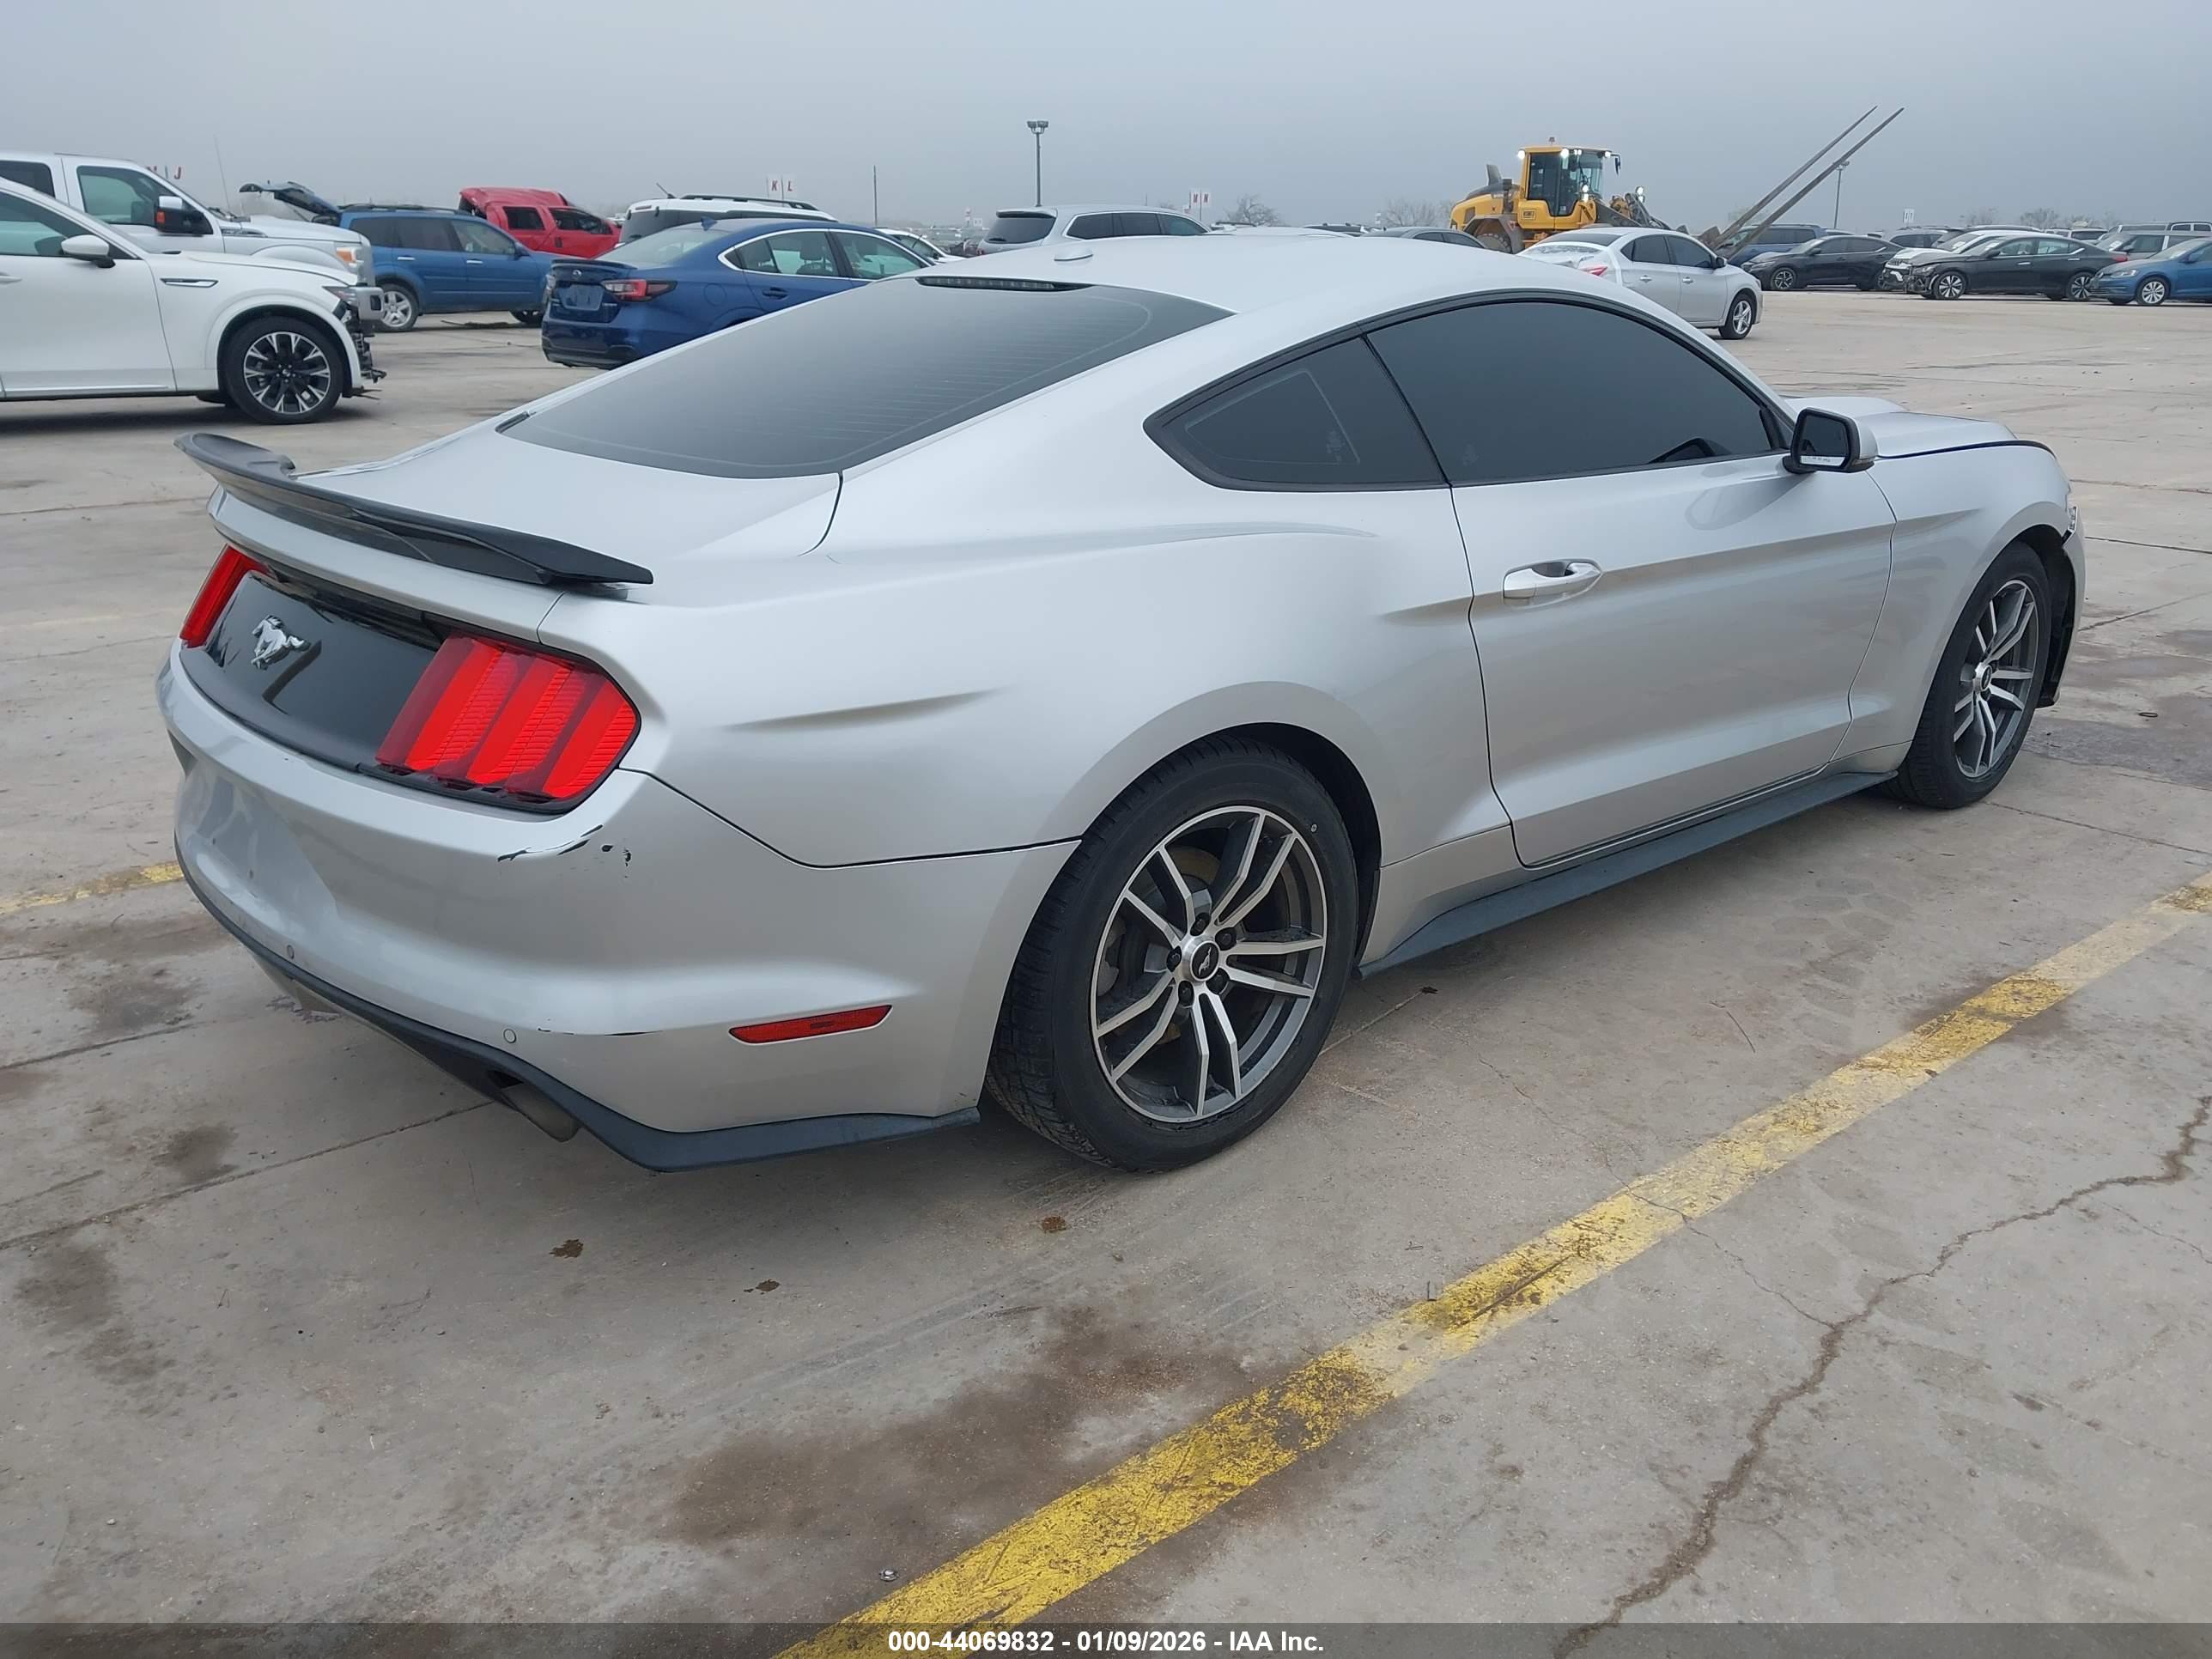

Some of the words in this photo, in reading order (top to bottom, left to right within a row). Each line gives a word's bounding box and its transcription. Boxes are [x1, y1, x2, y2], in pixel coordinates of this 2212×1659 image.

[173, 167, 181, 179] J
[771, 179, 778, 191] K
[787, 180, 793, 191] L
